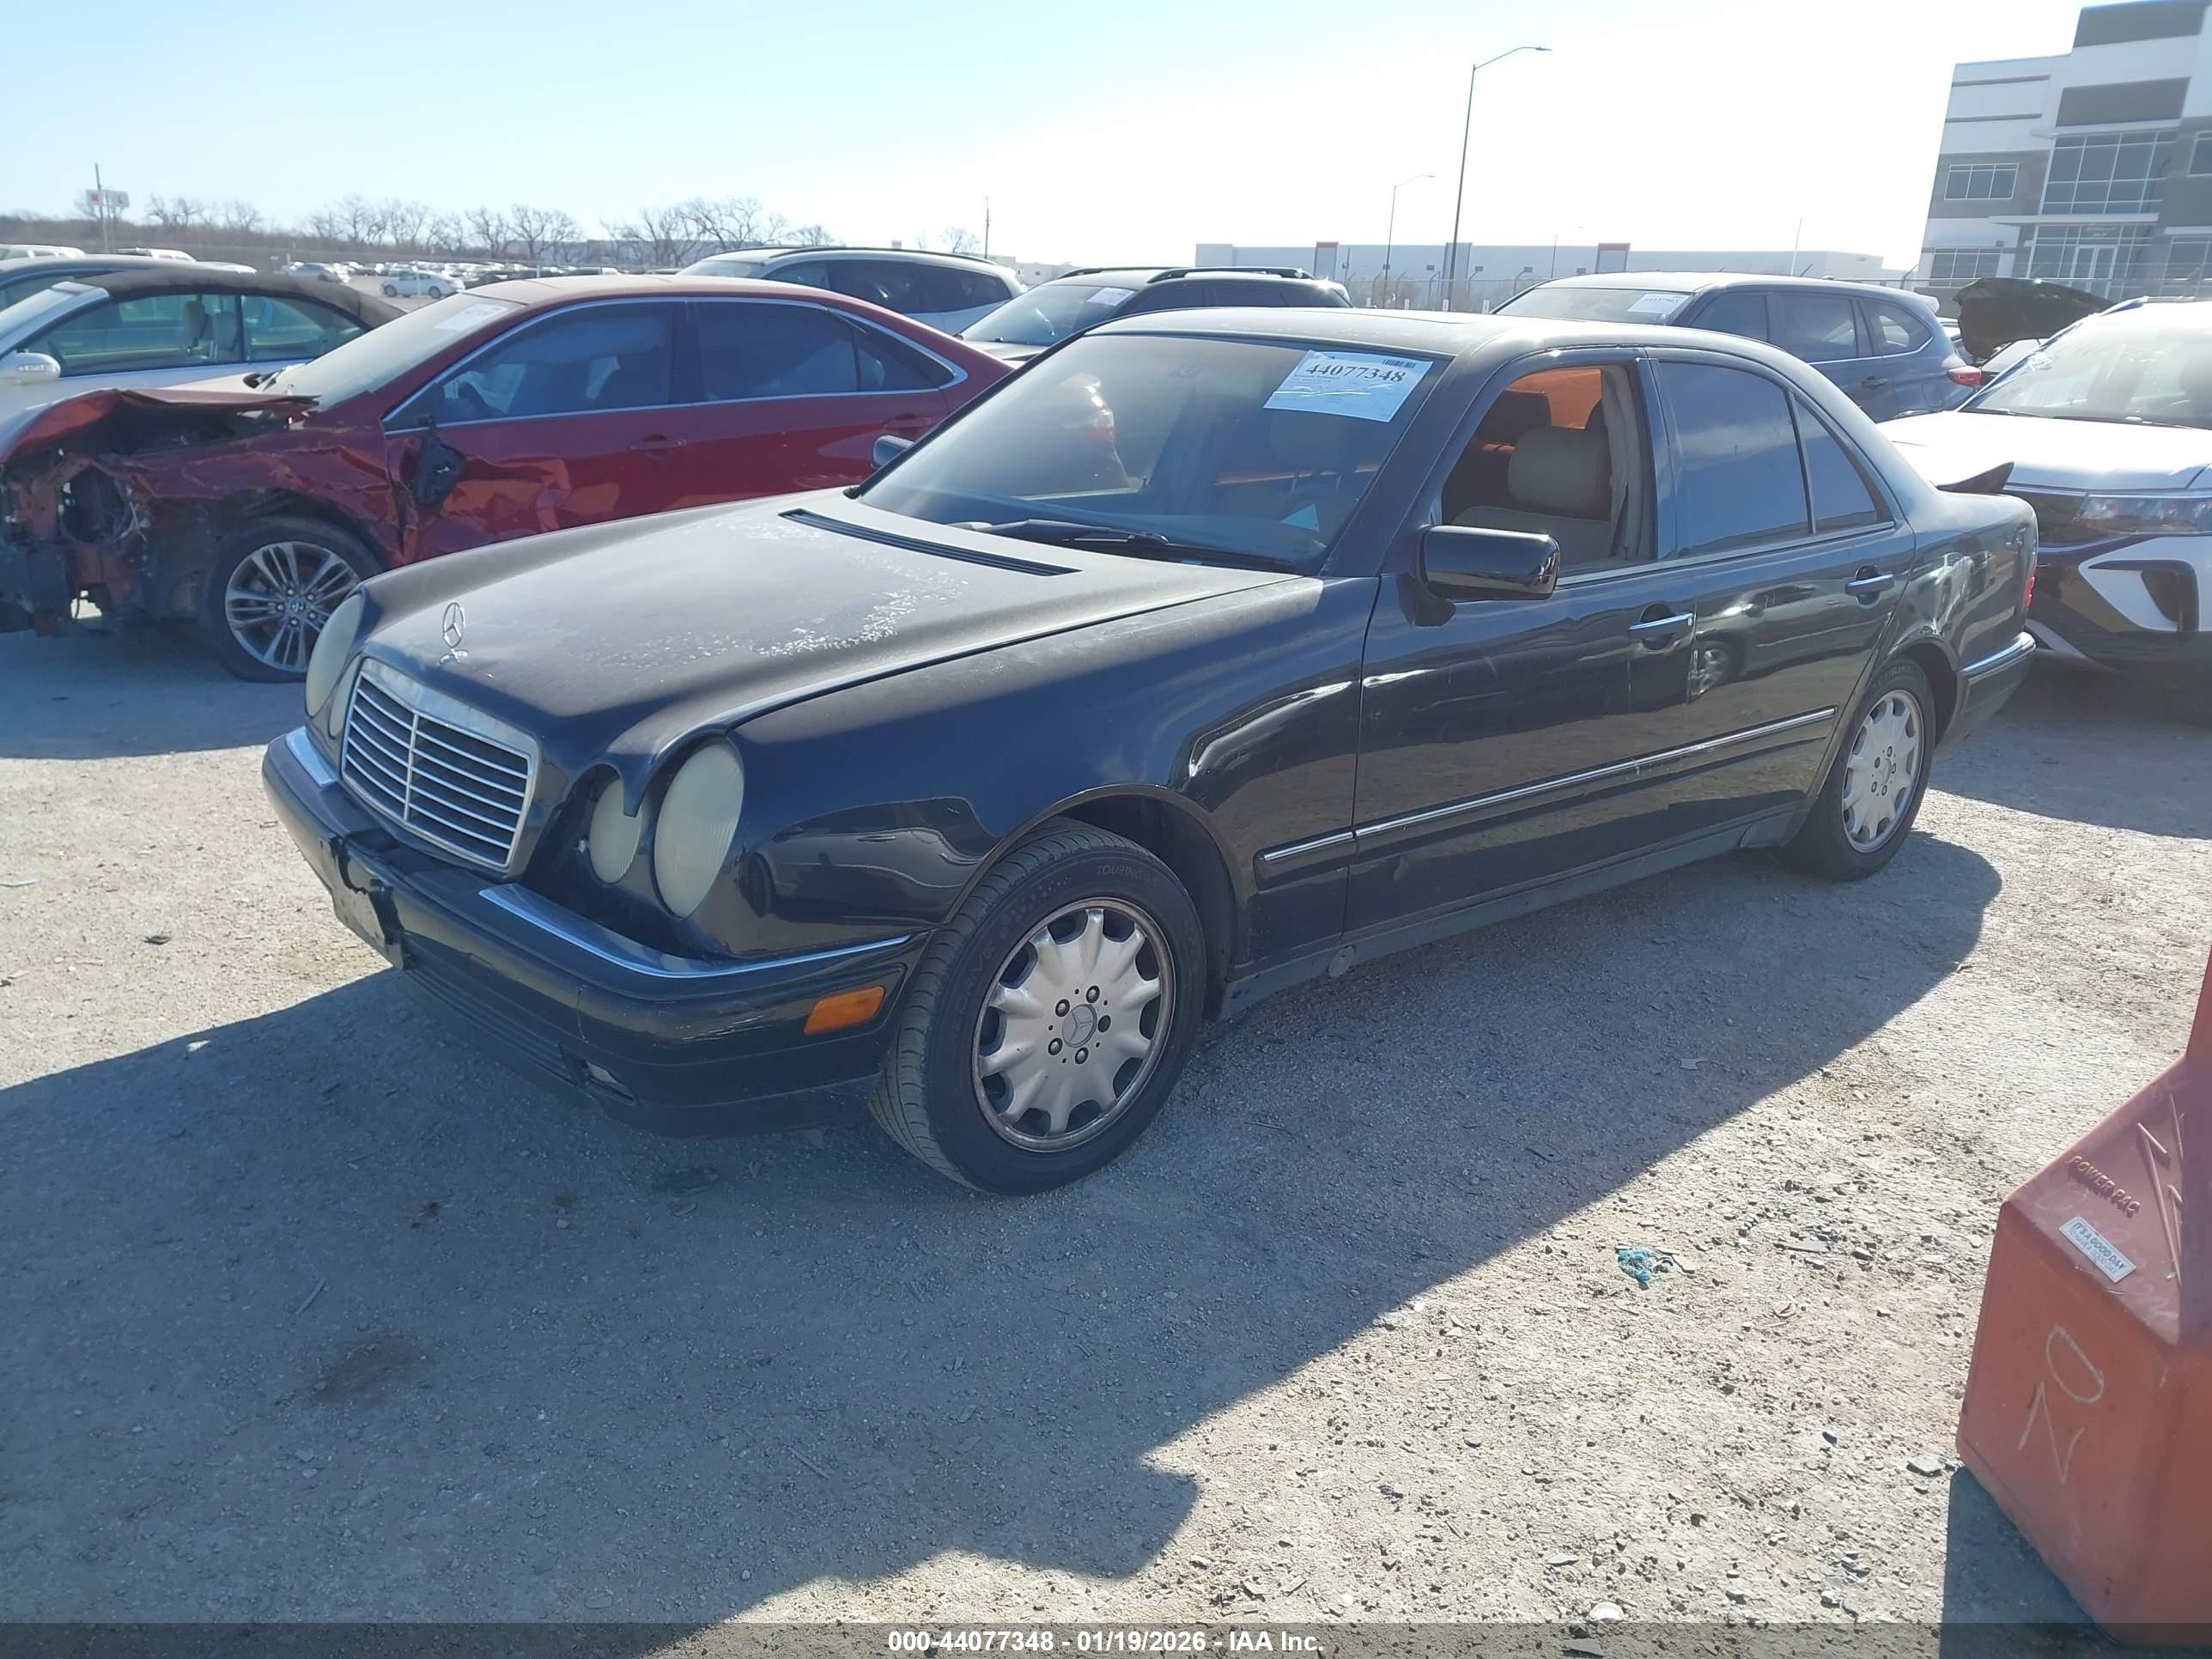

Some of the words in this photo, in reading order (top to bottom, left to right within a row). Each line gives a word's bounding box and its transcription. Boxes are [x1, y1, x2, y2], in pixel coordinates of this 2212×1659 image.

[1306, 363, 1406, 383] 44077348
[1096, 865, 1142, 880] TOURING
[2068, 1155, 2117, 1189] POWER
[2089, 1237, 2112, 1257] GOOD
[2108, 1255, 2127, 1270] DAY
